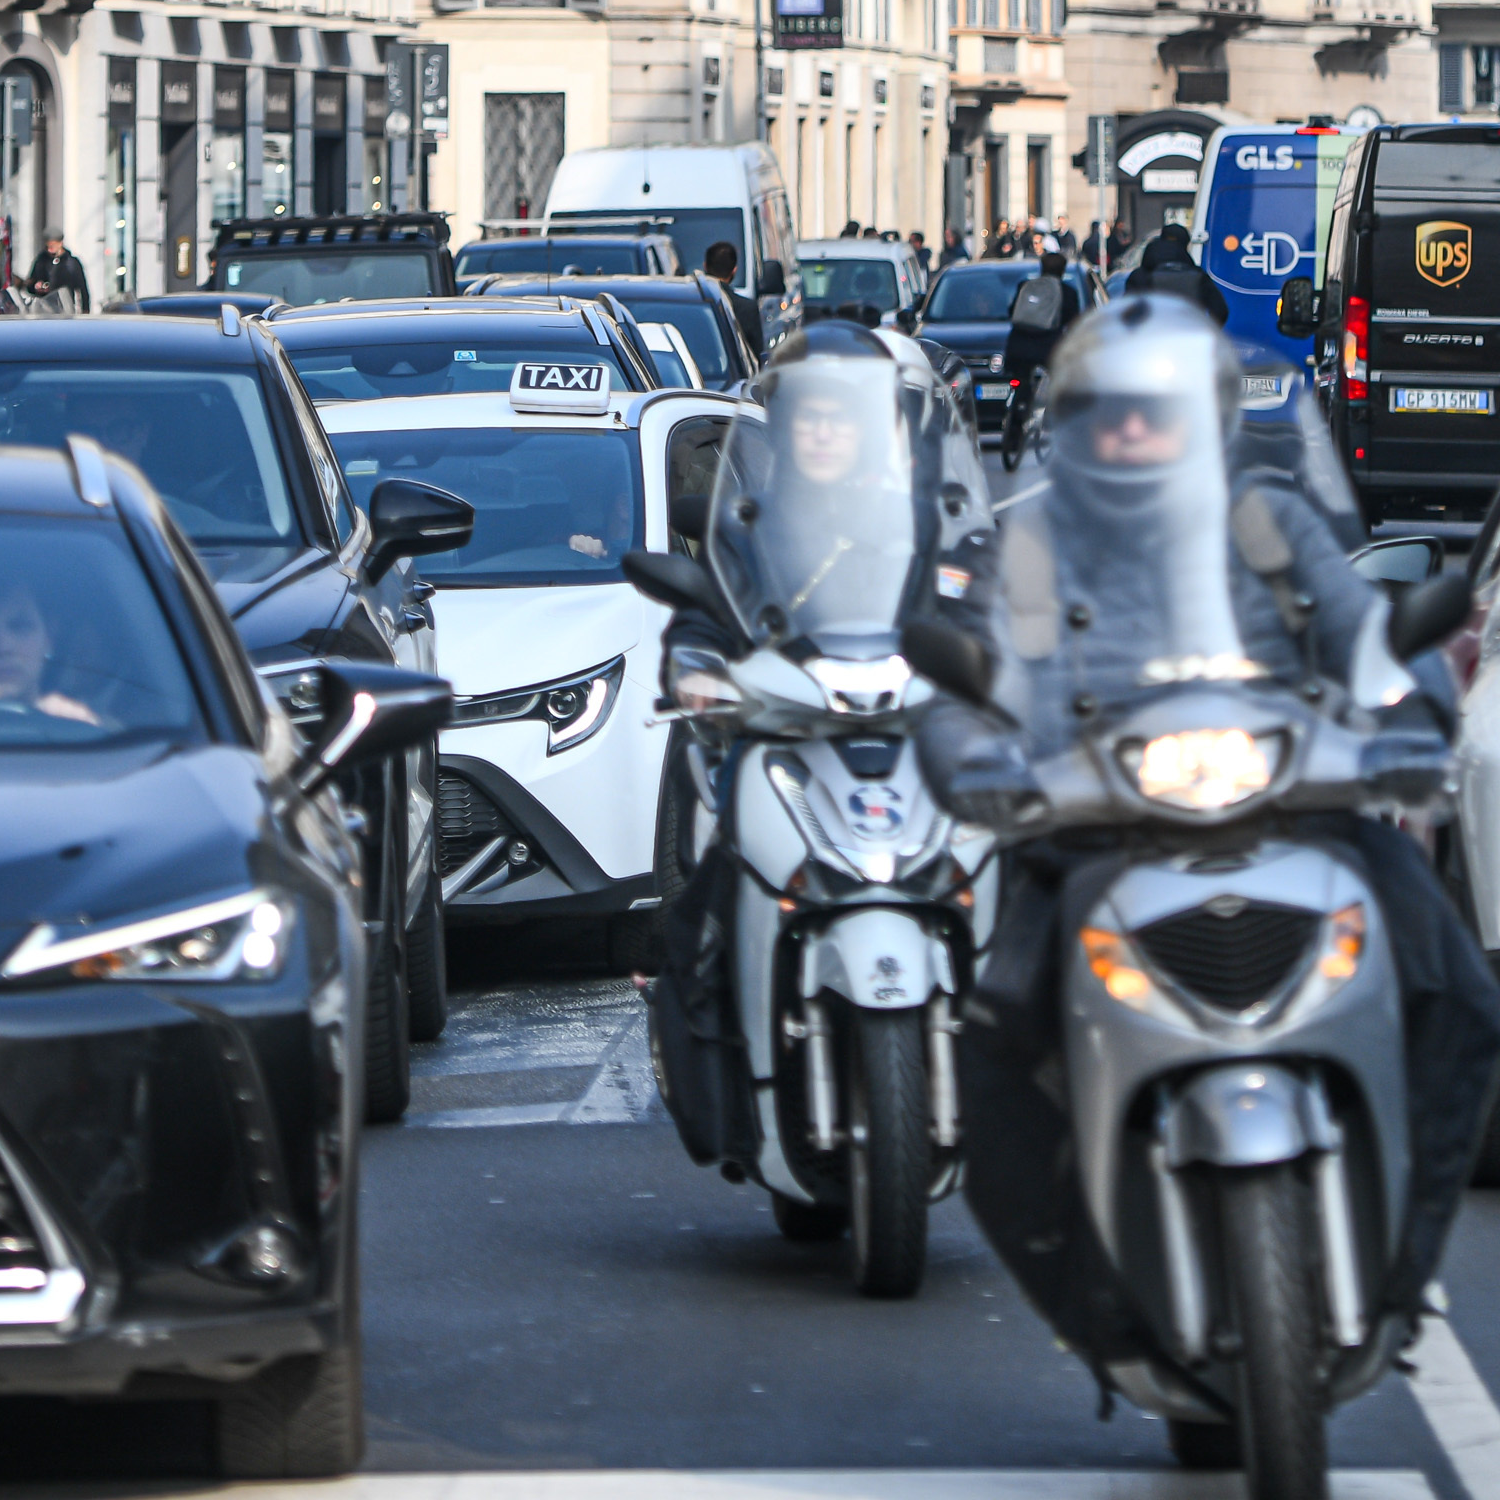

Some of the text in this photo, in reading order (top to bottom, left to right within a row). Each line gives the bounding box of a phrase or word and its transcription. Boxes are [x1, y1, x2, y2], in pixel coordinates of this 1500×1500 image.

[778, 16, 842, 33] LIBERO
[1420, 240, 1467, 277] ups
[1403, 333, 1473, 345] DUCATO
[524, 365, 599, 390] TAXI
